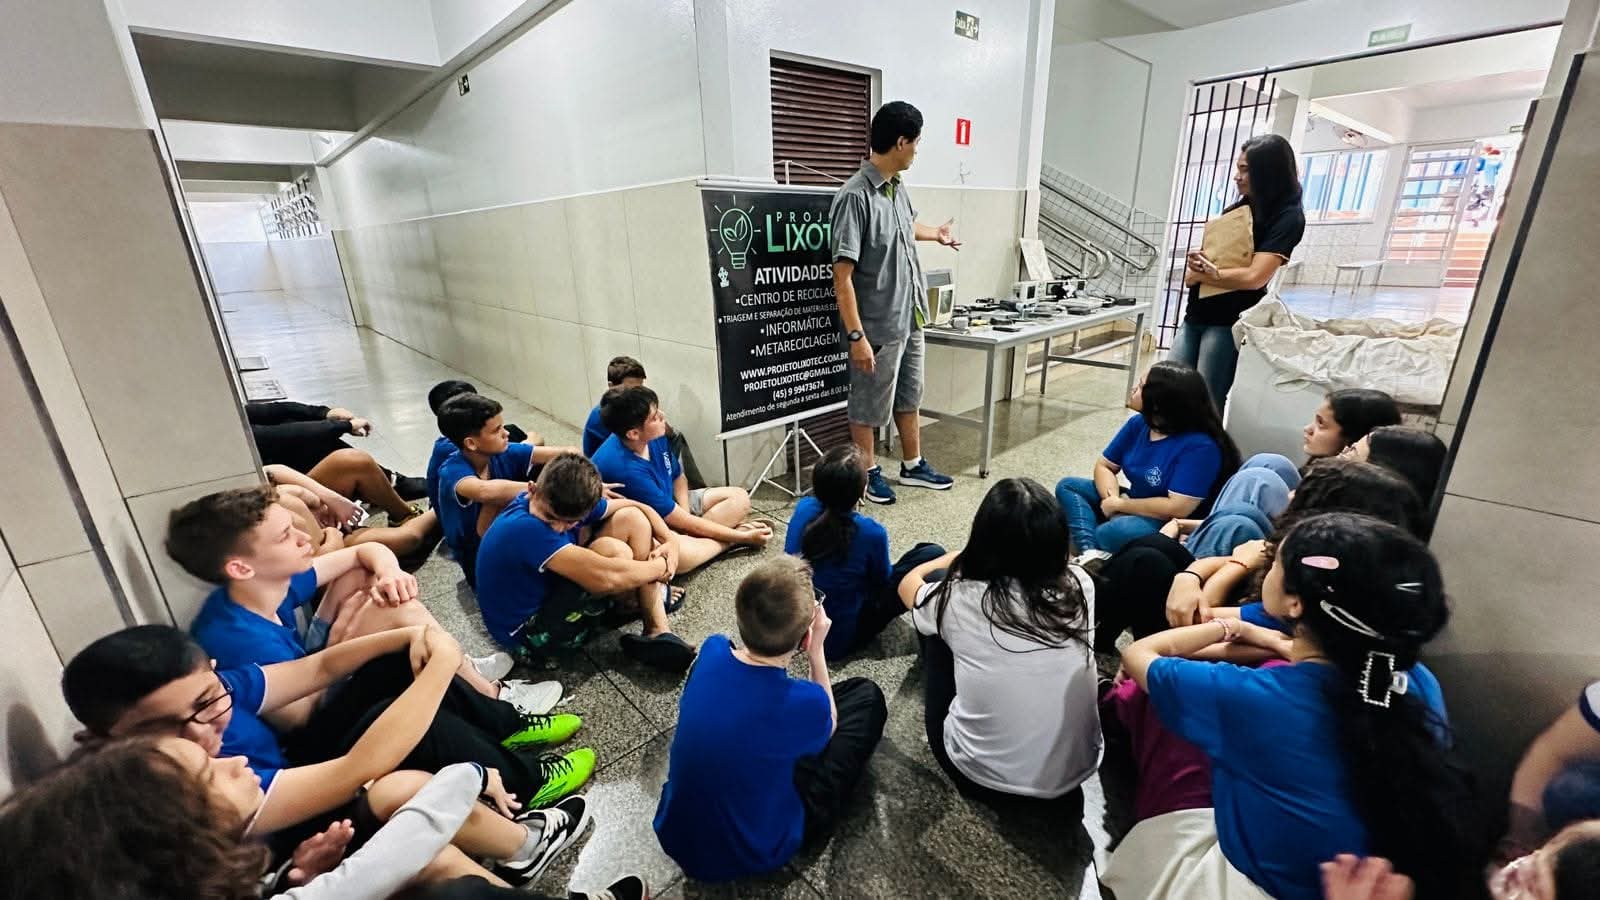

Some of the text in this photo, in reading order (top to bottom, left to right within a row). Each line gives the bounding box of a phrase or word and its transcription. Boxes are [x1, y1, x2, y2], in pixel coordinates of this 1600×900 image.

[776, 211, 823, 222] PROJ
[766, 215, 832, 252] LIXOT
[754, 264, 833, 285] ATIVIDADES
[741, 287, 836, 306] CENTRO DE RECICLAG
[723, 312, 753, 323] TRIAGEM
[754, 312, 758, 320] E
[760, 307, 793, 319] SEPARAÇÃO
[794, 306, 801, 315] DE
[802, 304, 829, 314] MATERIAIS
[765, 316, 832, 336] INFORMÁTICA
[755, 333, 840, 356] METARECICLAGEM
[740, 352, 848, 380] WWW.PROJETOLIXOTEC.COM.BR
[744, 363, 846, 392] PROJETOLIXOTEC@GMAIL.COM
[773, 380, 825, 401] (45) 9 99473674
[726, 406, 766, 421] Atendimento
[767, 402, 775, 410] de
[776, 397, 801, 409] segunda
[805, 393, 820, 402] sexta
[820, 389, 830, 398] das
